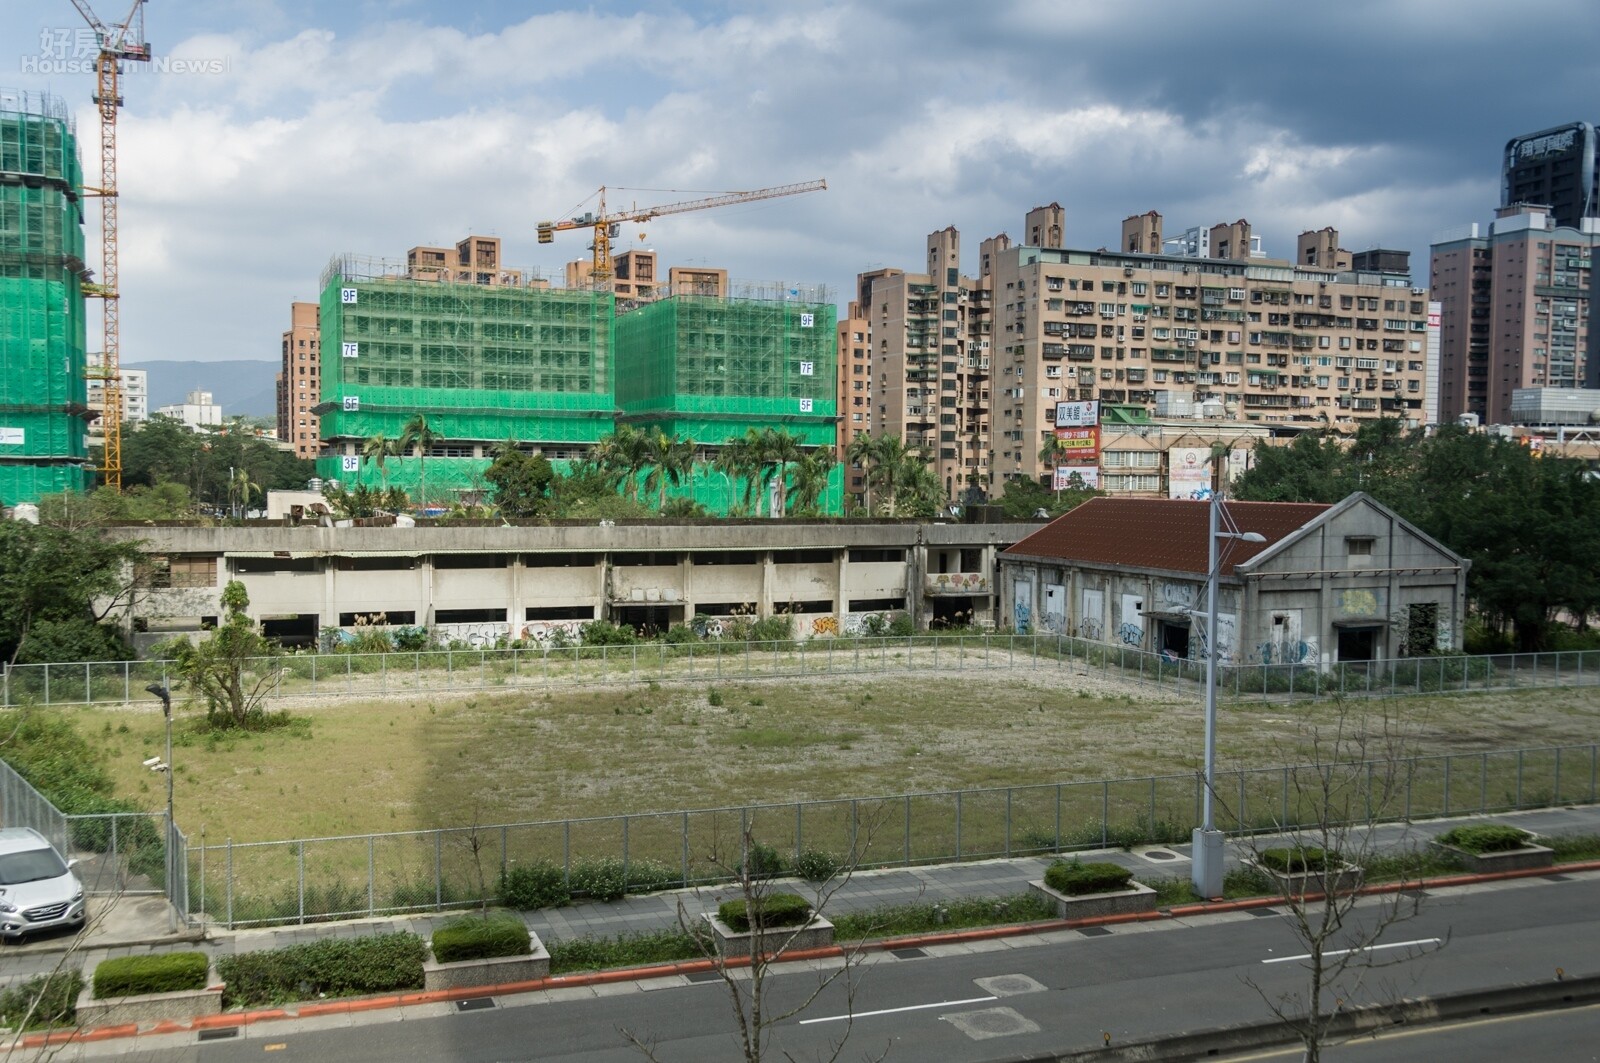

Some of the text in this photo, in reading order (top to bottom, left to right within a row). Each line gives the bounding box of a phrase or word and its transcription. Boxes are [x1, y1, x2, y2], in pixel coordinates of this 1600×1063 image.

[343, 290, 356, 302] 9F
[802, 315, 812, 326] 9F
[344, 344, 357, 356] 7F
[802, 363, 812, 374] 7F
[345, 398, 357, 410] 5F
[801, 400, 811, 411] 5F
[344, 457, 357, 469] 3F
